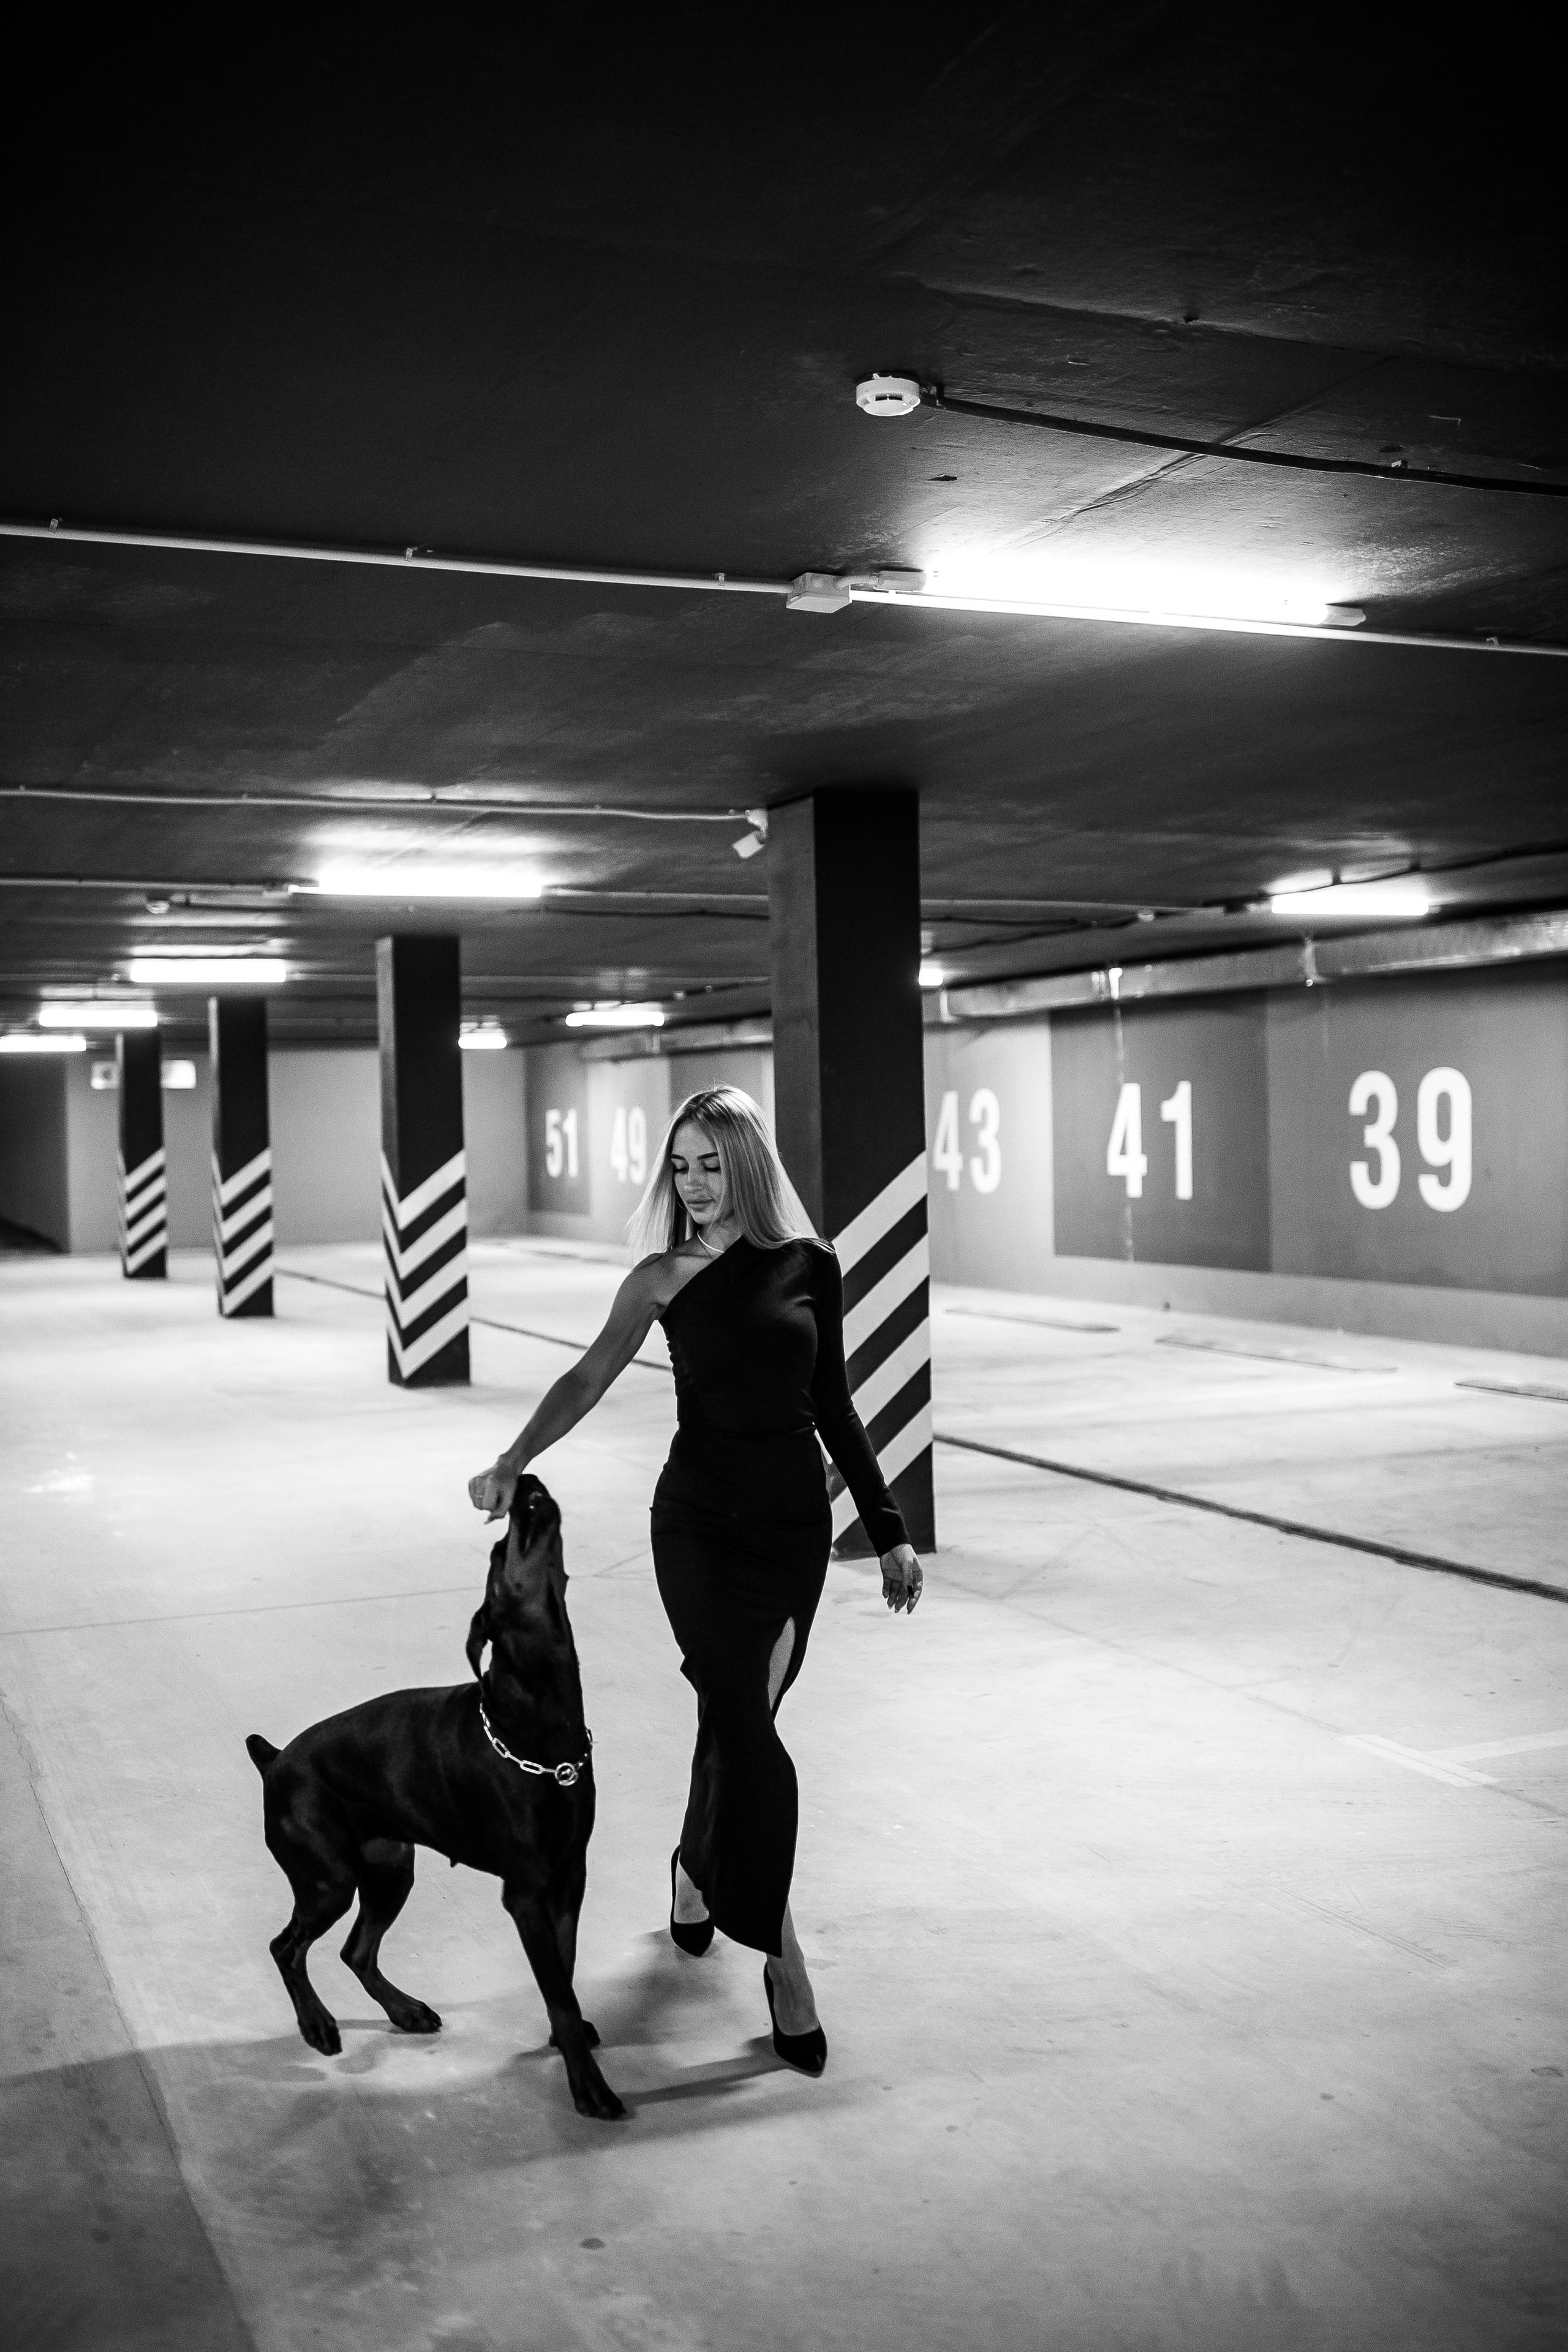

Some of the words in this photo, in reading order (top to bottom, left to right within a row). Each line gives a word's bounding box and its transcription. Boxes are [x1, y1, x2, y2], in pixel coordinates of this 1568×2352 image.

[546, 1109, 579, 1178] 51
[611, 1107, 646, 1183] 49
[934, 1089, 1001, 1193] 43
[1107, 1081, 1193, 1199] 41
[1349, 1066, 1473, 1212] 39
